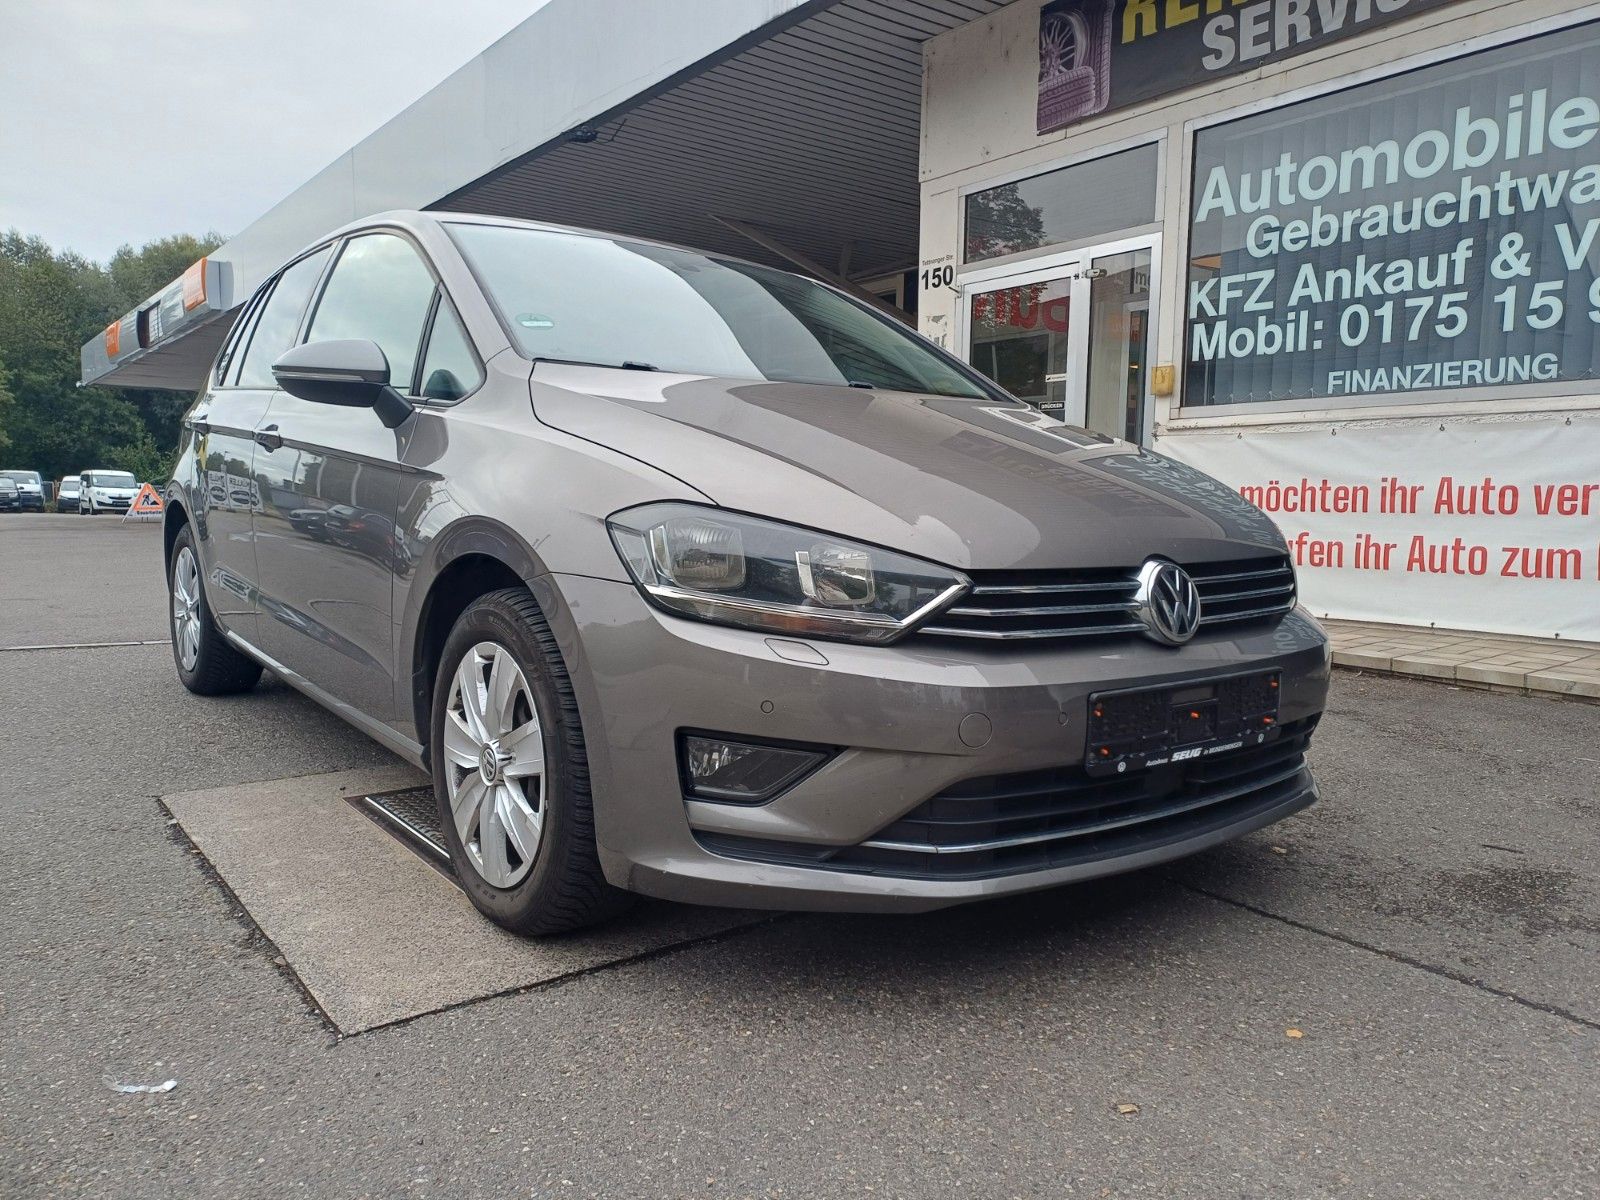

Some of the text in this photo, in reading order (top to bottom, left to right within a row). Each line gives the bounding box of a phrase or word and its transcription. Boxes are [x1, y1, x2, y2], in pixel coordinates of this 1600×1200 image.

[921, 265, 954, 290] 150
[1189, 269, 1276, 319] KFZ
[1287, 238, 1473, 307] Ankauf
[1490, 231, 1531, 279] &
[1191, 310, 1324, 362] Mobil:
[1339, 291, 1468, 347] 0175
[1494, 280, 1564, 332] 15
[1327, 352, 1558, 394] FINANZIERUNG
[1240, 478, 1368, 514] möchten
[1380, 477, 1424, 514] ihr
[1434, 477, 1519, 515] Auto
[1534, 484, 1599, 515] ver
[1354, 533, 1397, 570] ihr
[1407, 535, 1488, 576] Auto
[1501, 547, 1581, 580] zum
